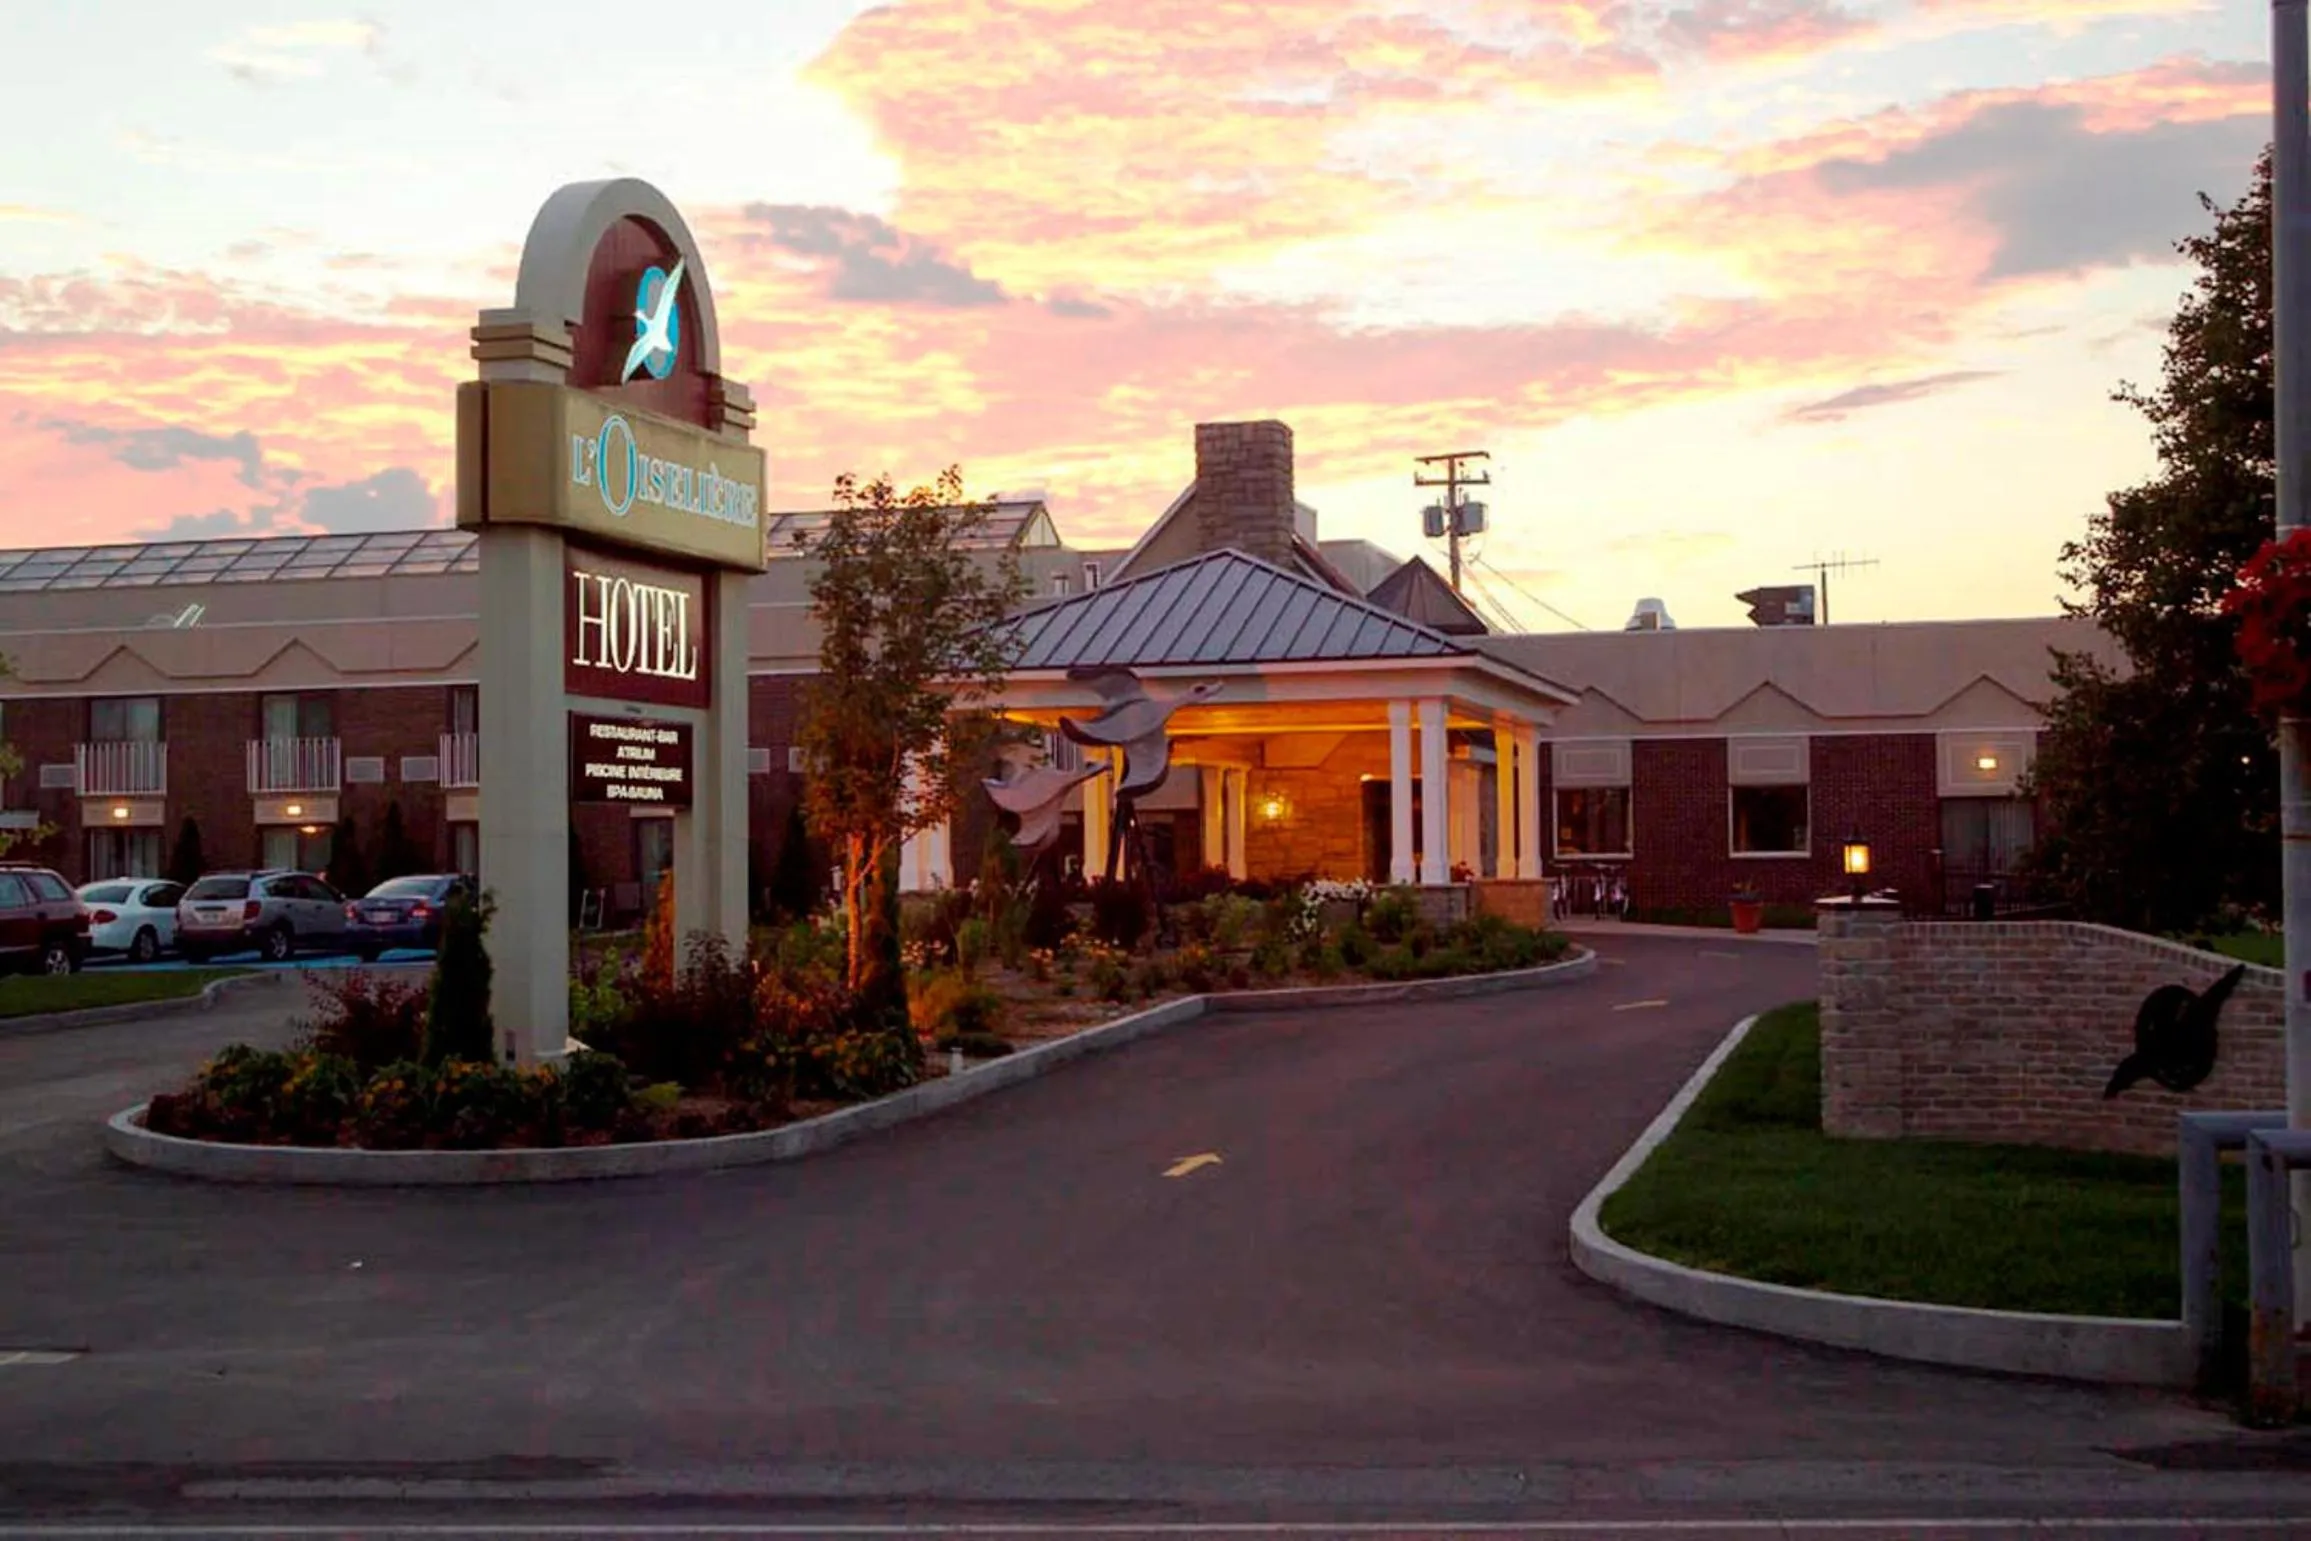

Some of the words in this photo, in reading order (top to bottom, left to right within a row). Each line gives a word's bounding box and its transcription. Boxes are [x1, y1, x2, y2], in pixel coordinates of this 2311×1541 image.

[572, 414, 758, 528] L'OISELIÈRE
[573, 571, 696, 681] HOTEL
[585, 763, 627, 779] PISCINE
[616, 745, 656, 760] ATRIUM
